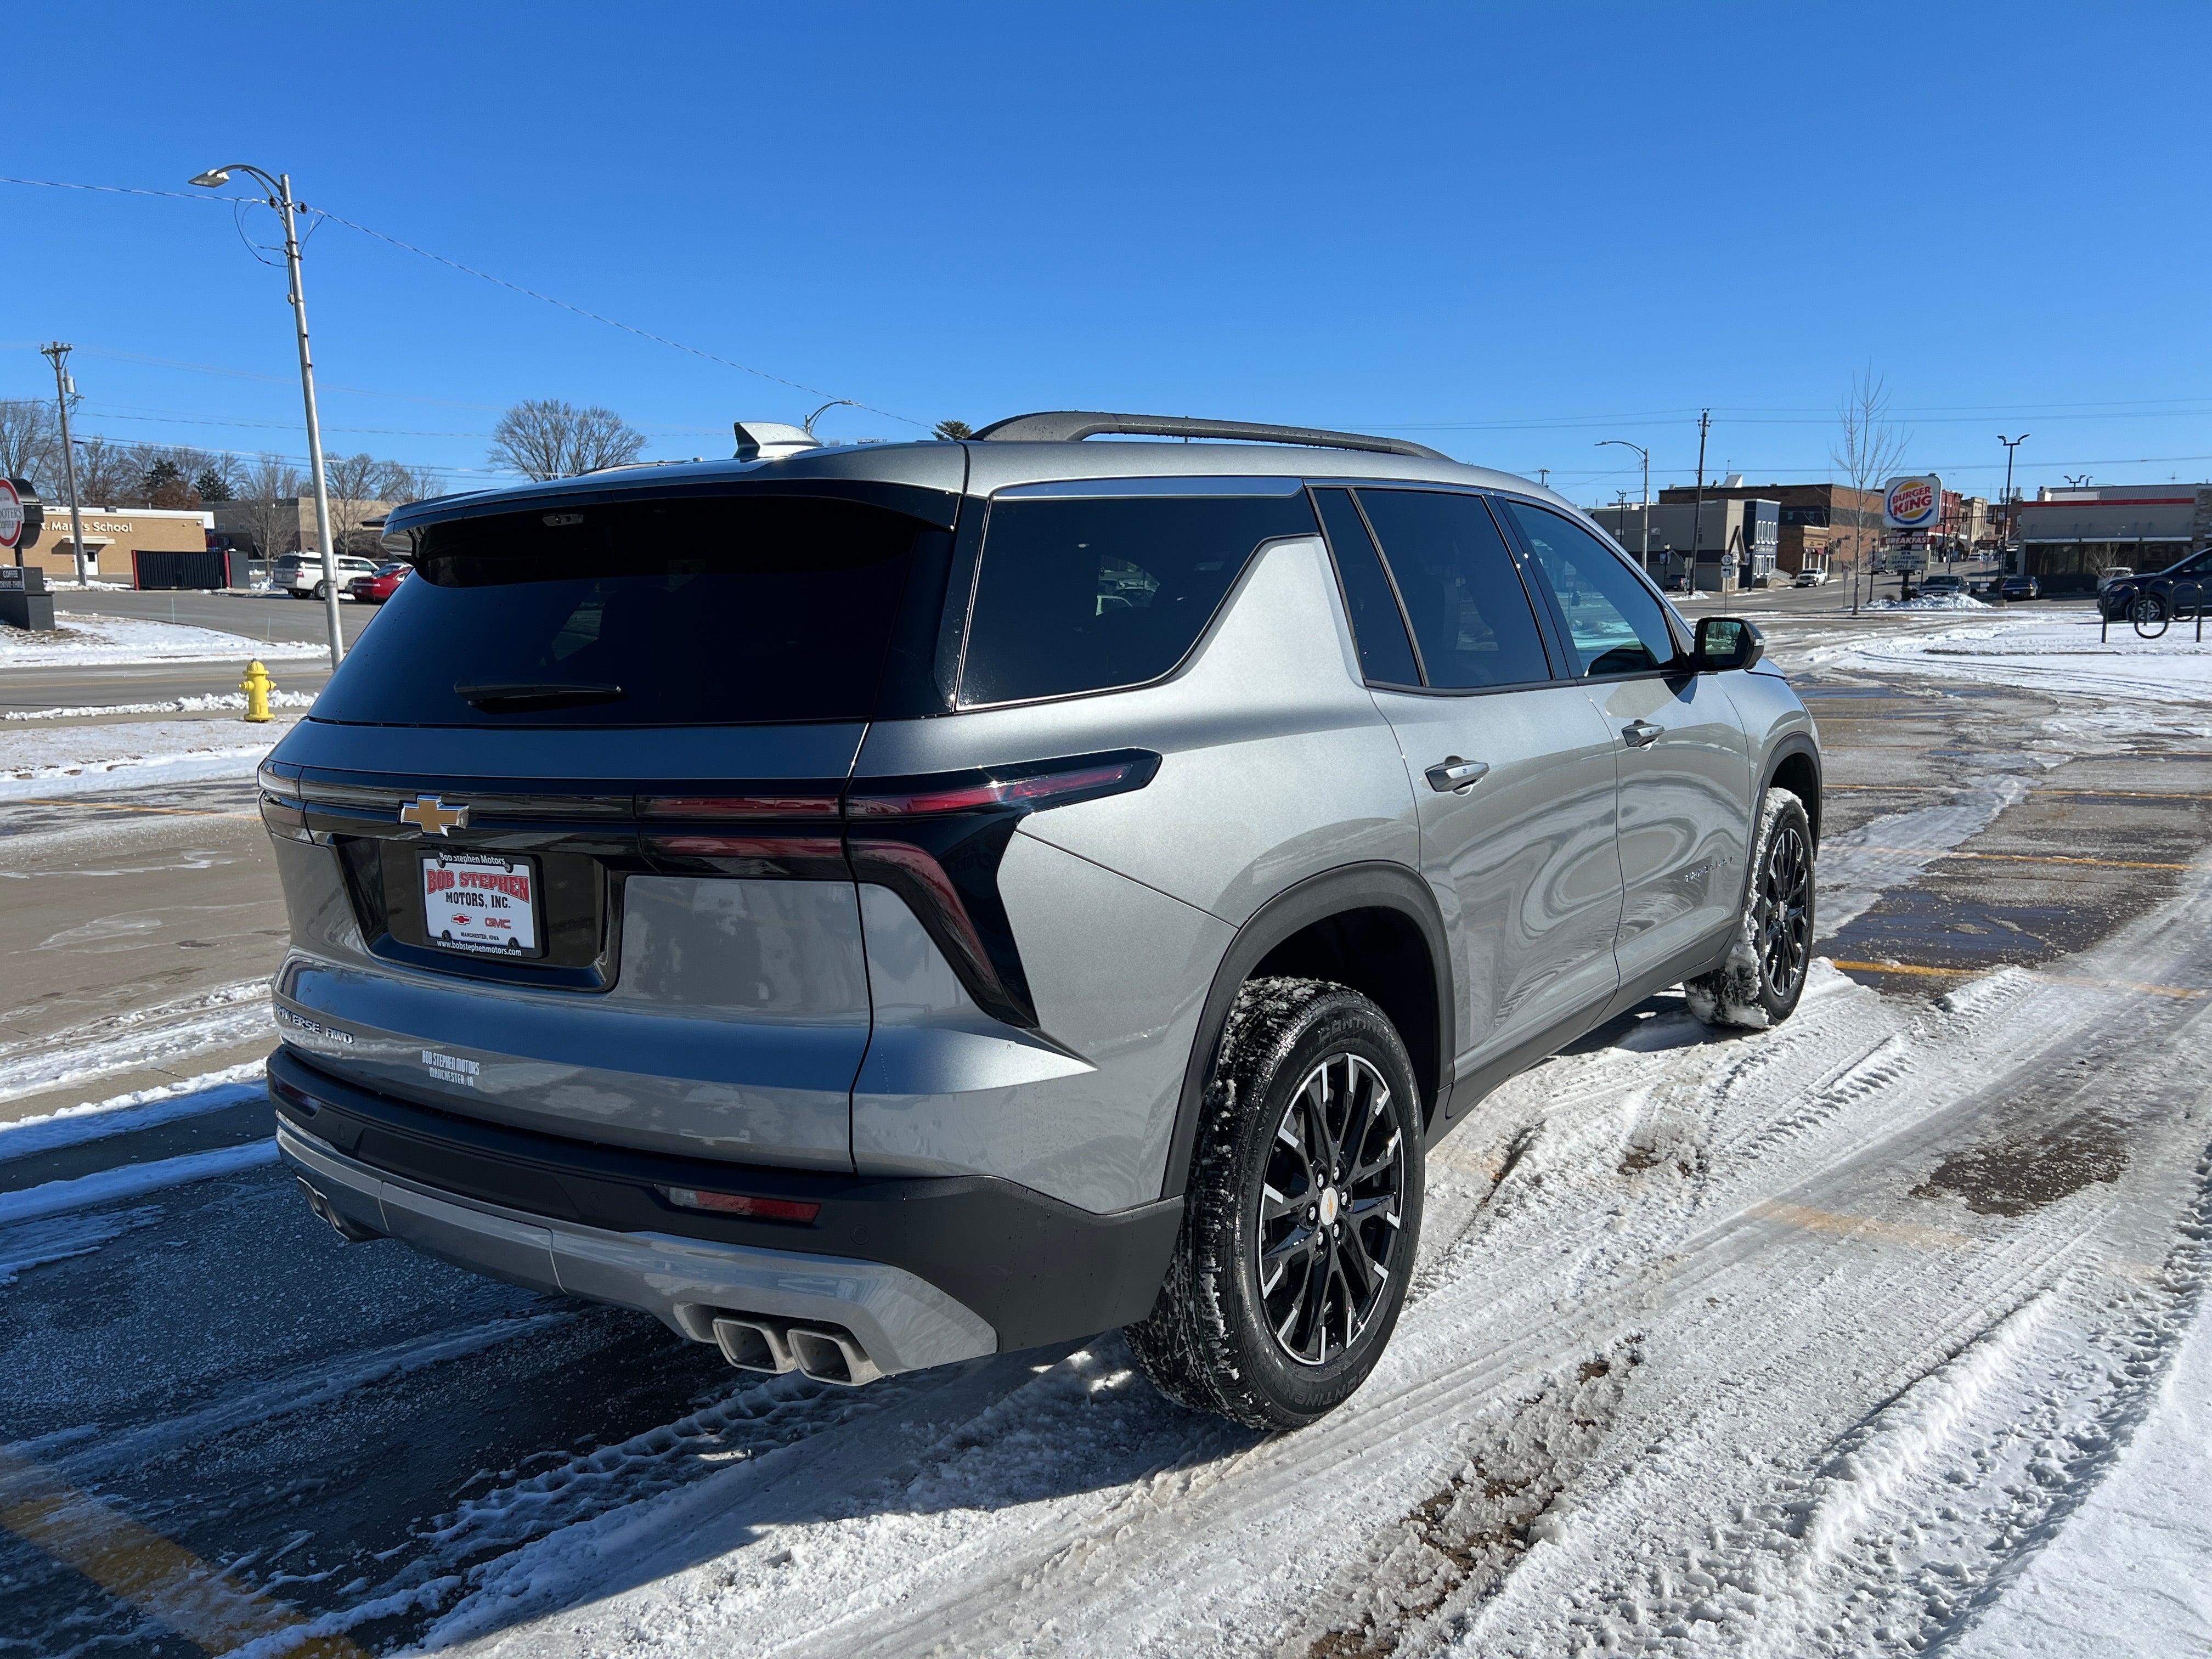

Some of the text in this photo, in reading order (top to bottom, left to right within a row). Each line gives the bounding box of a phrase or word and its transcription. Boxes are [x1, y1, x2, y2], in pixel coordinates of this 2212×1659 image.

[1892, 486, 1931, 504] BURGER
[1893, 495, 1932, 516] KING
[0, 507, 22, 519] OTER'S
[40, 521, 132, 533] t. Mar's School
[1886, 537, 1931, 545] BREAKFAST
[3, 570, 19, 578] COFFEE
[439, 852, 453, 861] Bob
[481, 855, 506, 865] Motors
[426, 869, 530, 904] BOB STEPHEN
[445, 892, 511, 909] MOTORS, INC.
[484, 917, 511, 929] GMC
[460, 932, 488, 940] MANCHESTER,
[437, 940, 522, 956] www.bobstephenmotors.com
[325, 1027, 354, 1045] AWD
[422, 1049, 480, 1076] BOB STEPHEN MOTORS
[467, 1076, 473, 1087] IA
